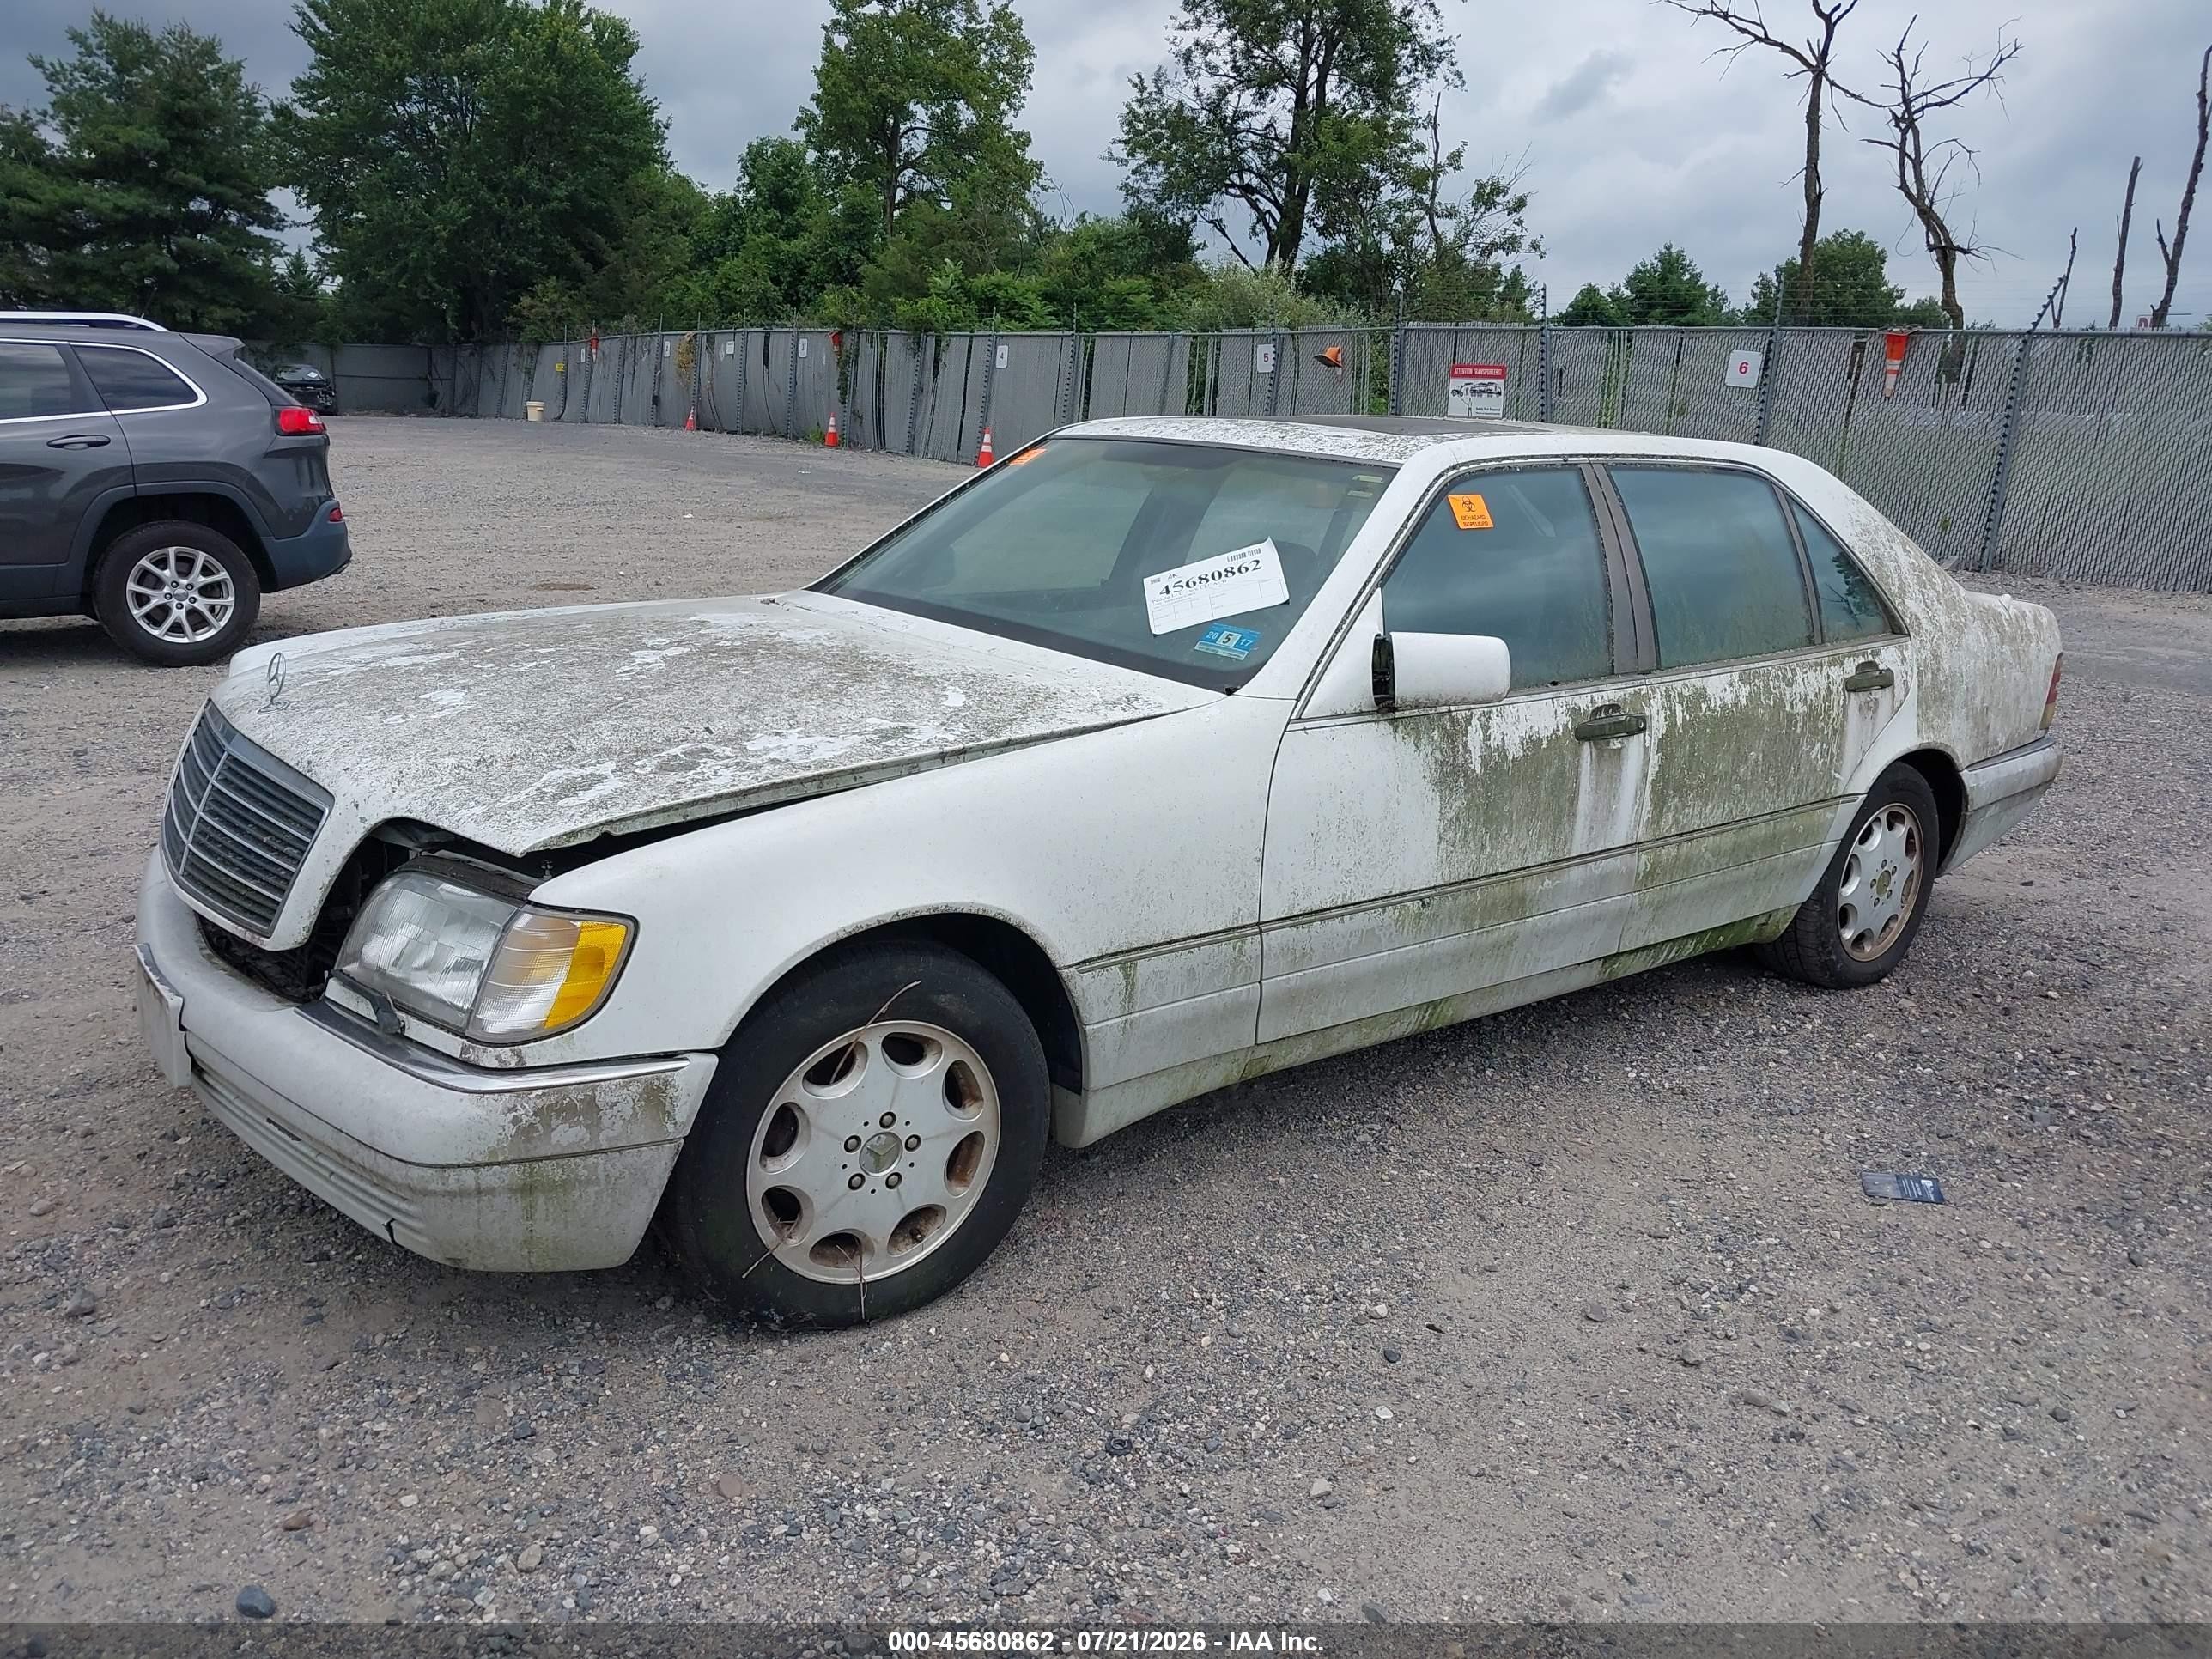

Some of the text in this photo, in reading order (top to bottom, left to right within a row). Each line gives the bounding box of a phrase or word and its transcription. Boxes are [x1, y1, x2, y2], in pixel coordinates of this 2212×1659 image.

[1263, 353, 1269, 362] 5
[1739, 362, 1749, 374] 6
[1159, 559, 1262, 596] 45680862
[1222, 634, 1234, 644] 5
[1240, 638, 1254, 647] 17
